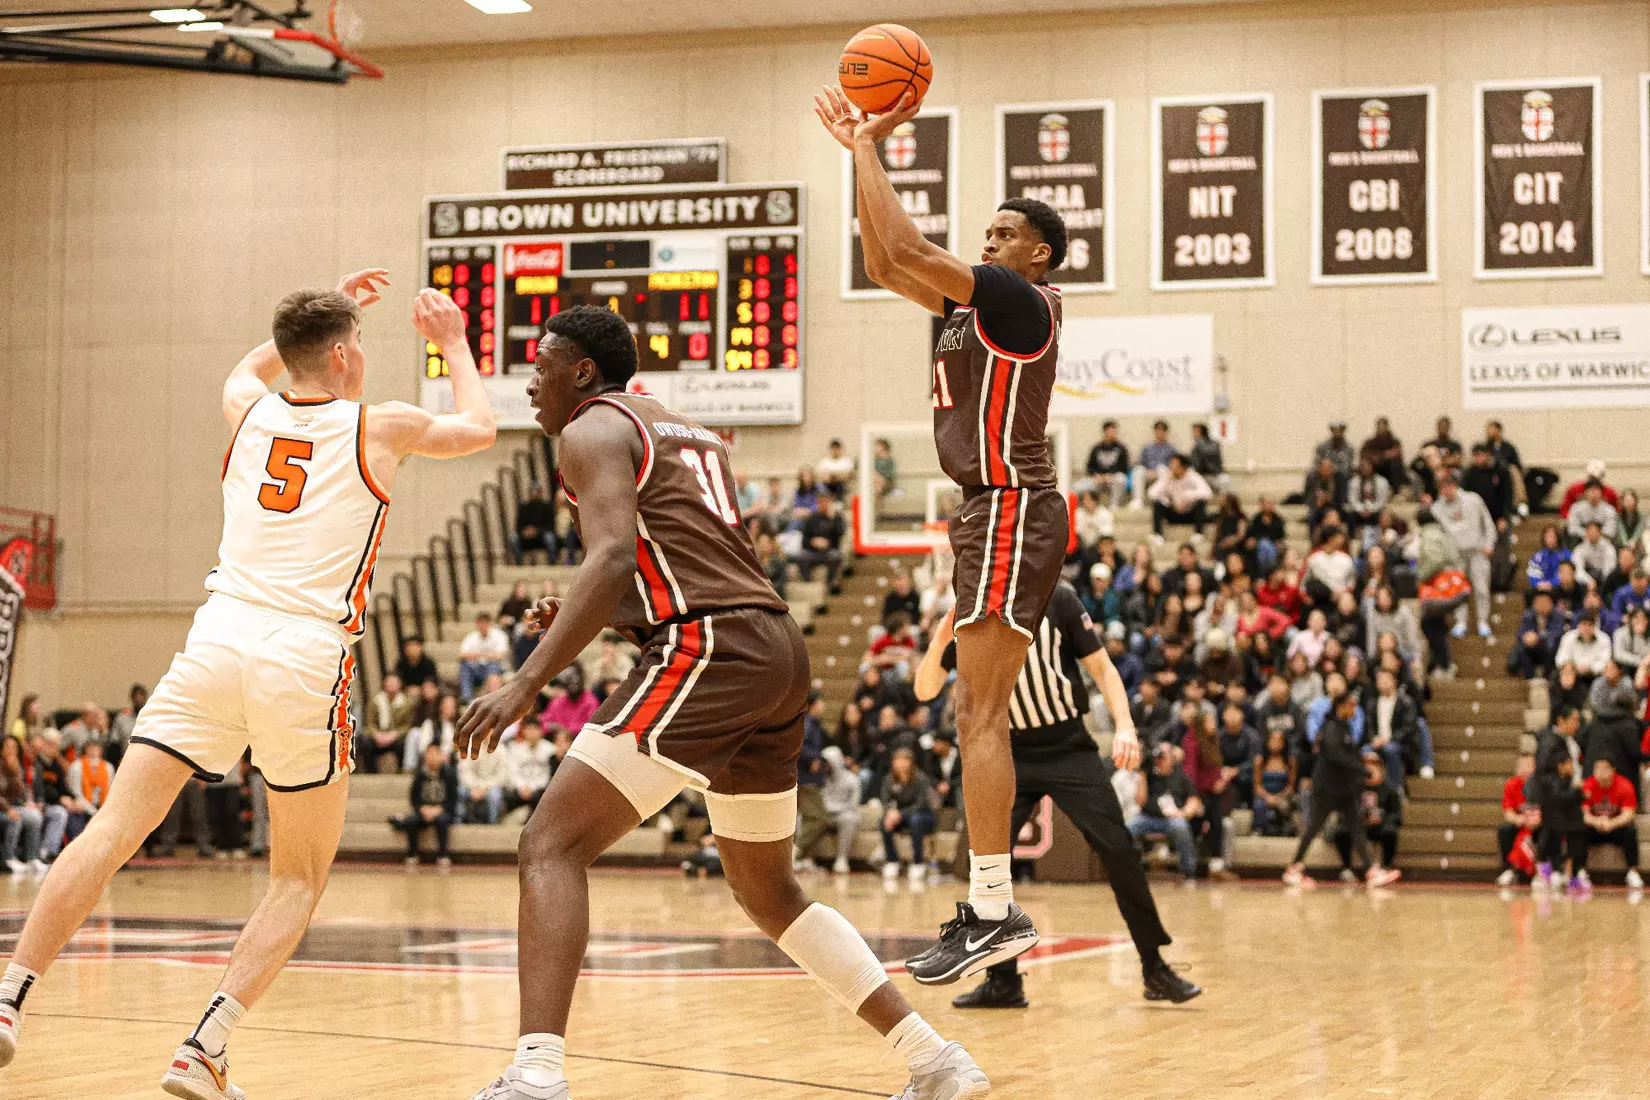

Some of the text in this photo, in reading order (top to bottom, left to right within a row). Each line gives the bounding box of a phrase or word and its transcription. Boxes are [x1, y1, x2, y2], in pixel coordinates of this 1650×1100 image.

[553, 165, 664, 187] SCOREBOARD
[1513, 171, 1563, 205] CIT
[1188, 185, 1237, 219] NIT
[1348, 178, 1400, 213] CBI
[463, 202, 574, 231] BROWN
[582, 196, 762, 227] UNIVERSITY
[1174, 232, 1251, 267] 2003
[1335, 227, 1414, 262] 2008
[1499, 220, 1577, 256] 2014
[679, 291, 709, 321] 11
[649, 334, 670, 359] 4
[688, 332, 709, 360] 0
[1511, 326, 1623, 346] LEXUS
[1469, 363, 1530, 381] LEXUS
[1536, 362, 1560, 379] OF
[257, 436, 314, 514] 5
[679, 445, 740, 527] 31
